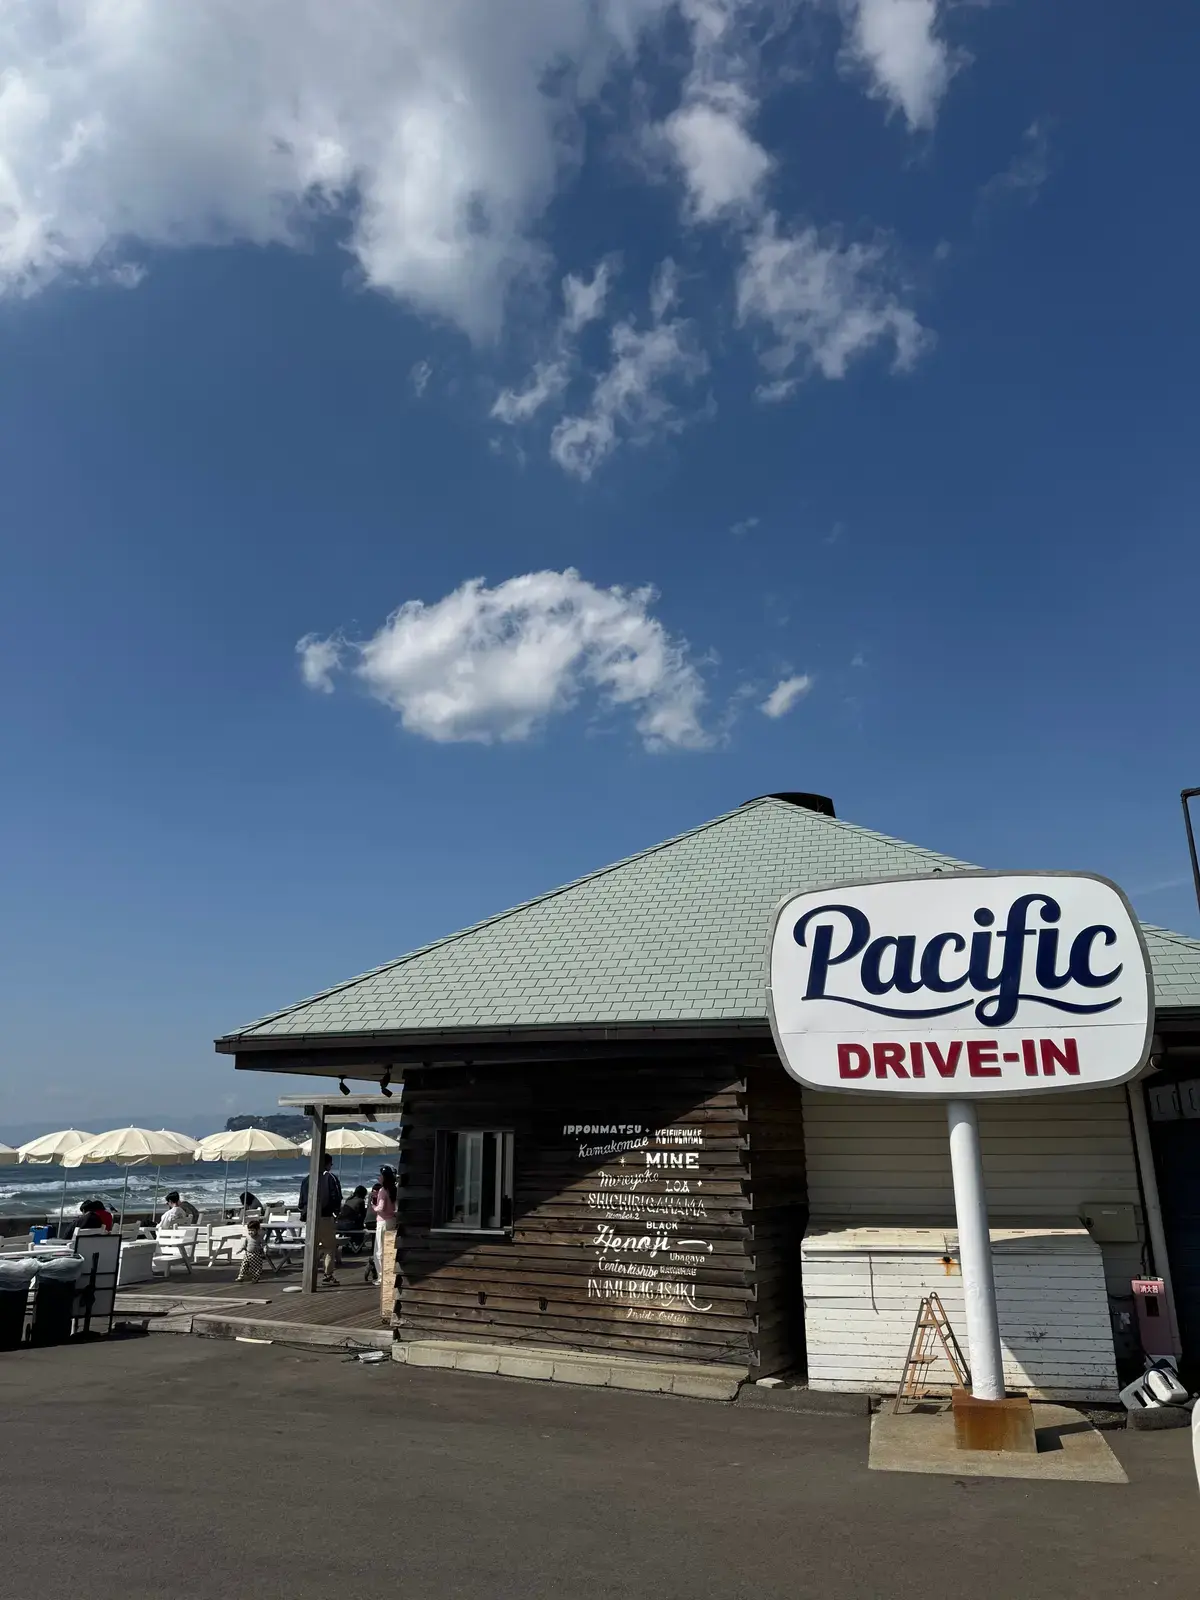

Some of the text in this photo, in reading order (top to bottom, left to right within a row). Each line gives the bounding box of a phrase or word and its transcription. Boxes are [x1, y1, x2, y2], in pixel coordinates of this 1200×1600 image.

[793, 893, 1123, 1027] Pacific
[837, 1038, 1081, 1079] DRIVE-IN
[563, 1124, 642, 1135] IPPONMATSU
[645, 1152, 700, 1169] MINE
[665, 1180, 690, 1192] LOA
[588, 1192, 707, 1217] SHICHIRIGAHAMA
[646, 1221, 678, 1230] BLACK
[669, 1252, 705, 1266] Ubagaya
[587, 1278, 712, 1311] INAMURAGASAKI
